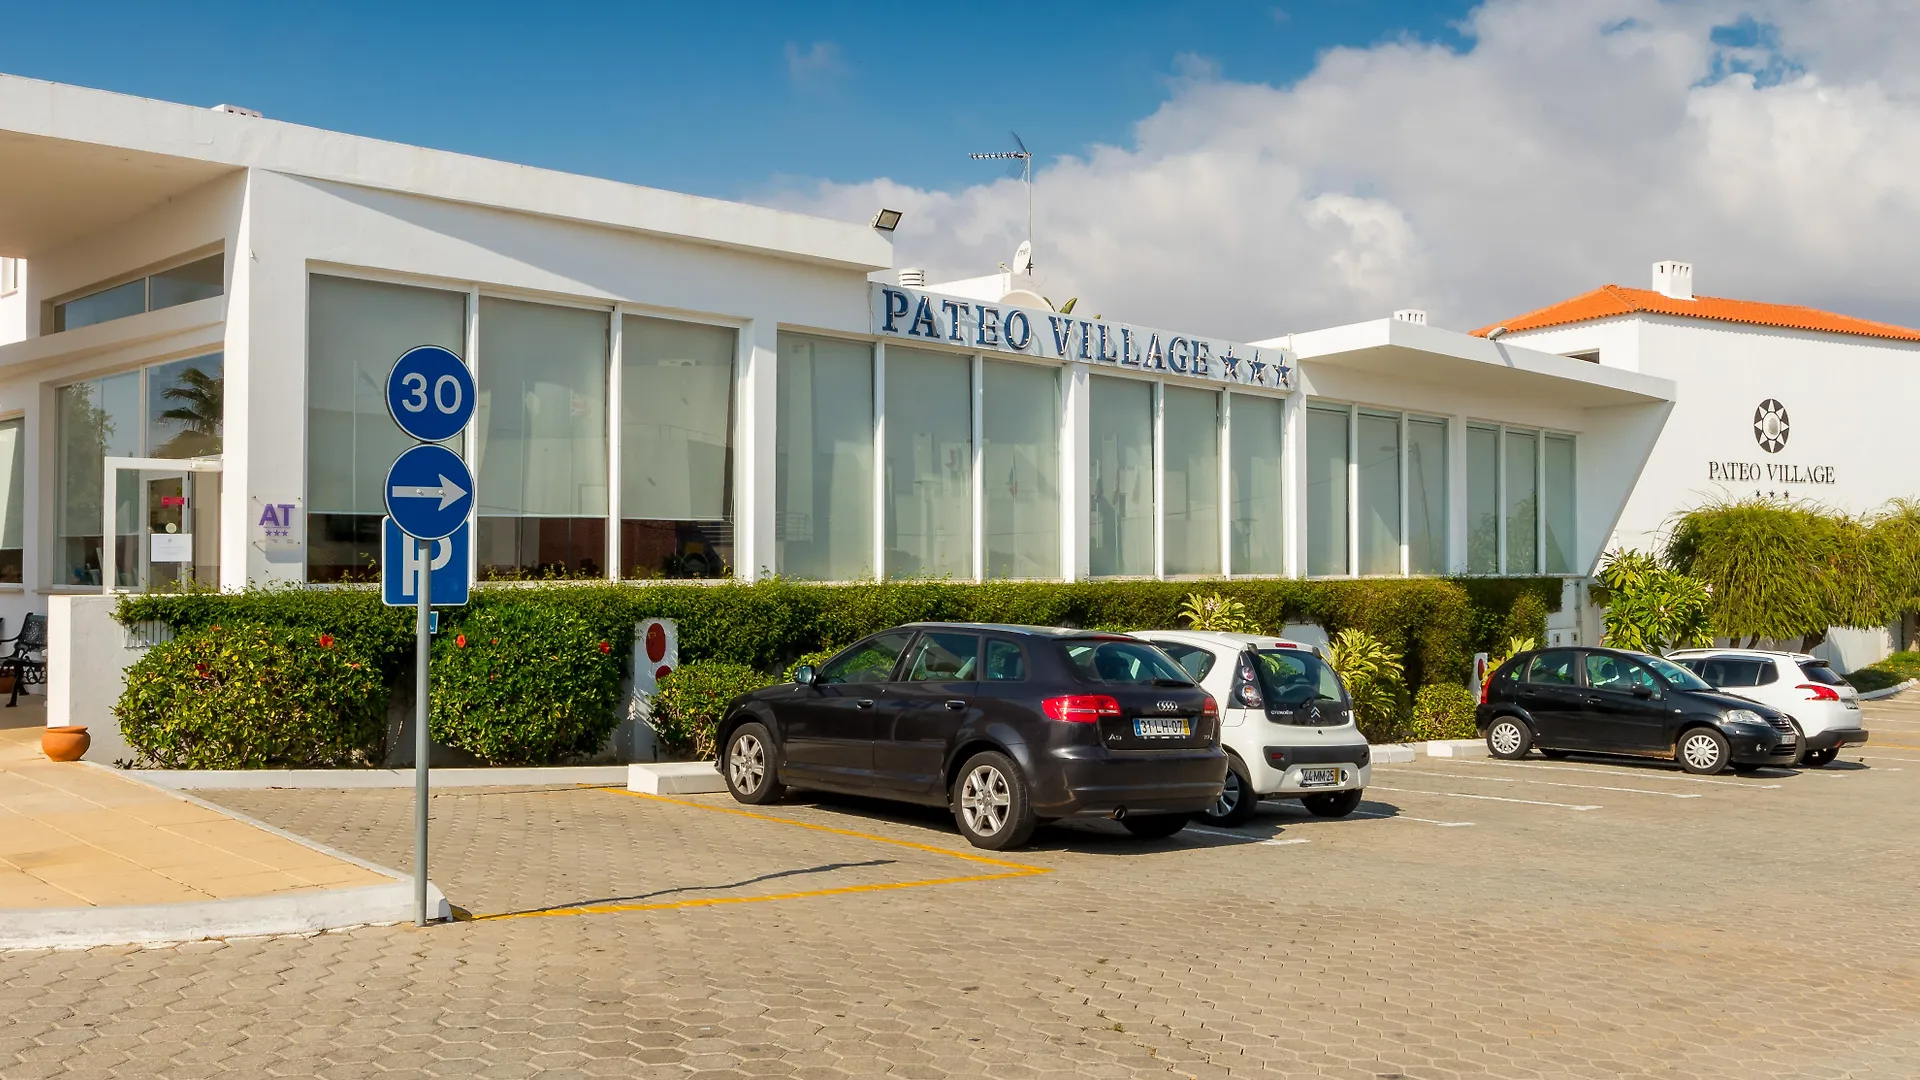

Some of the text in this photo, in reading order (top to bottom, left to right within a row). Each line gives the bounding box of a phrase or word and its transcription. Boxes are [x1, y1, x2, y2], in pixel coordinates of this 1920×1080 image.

[882, 288, 1210, 376] PATEO VILLAGE
[402, 372, 462, 415] 30
[1709, 461, 1836, 484] PATEO VILLAGE
[258, 503, 296, 526] AT
[402, 532, 453, 596] P
